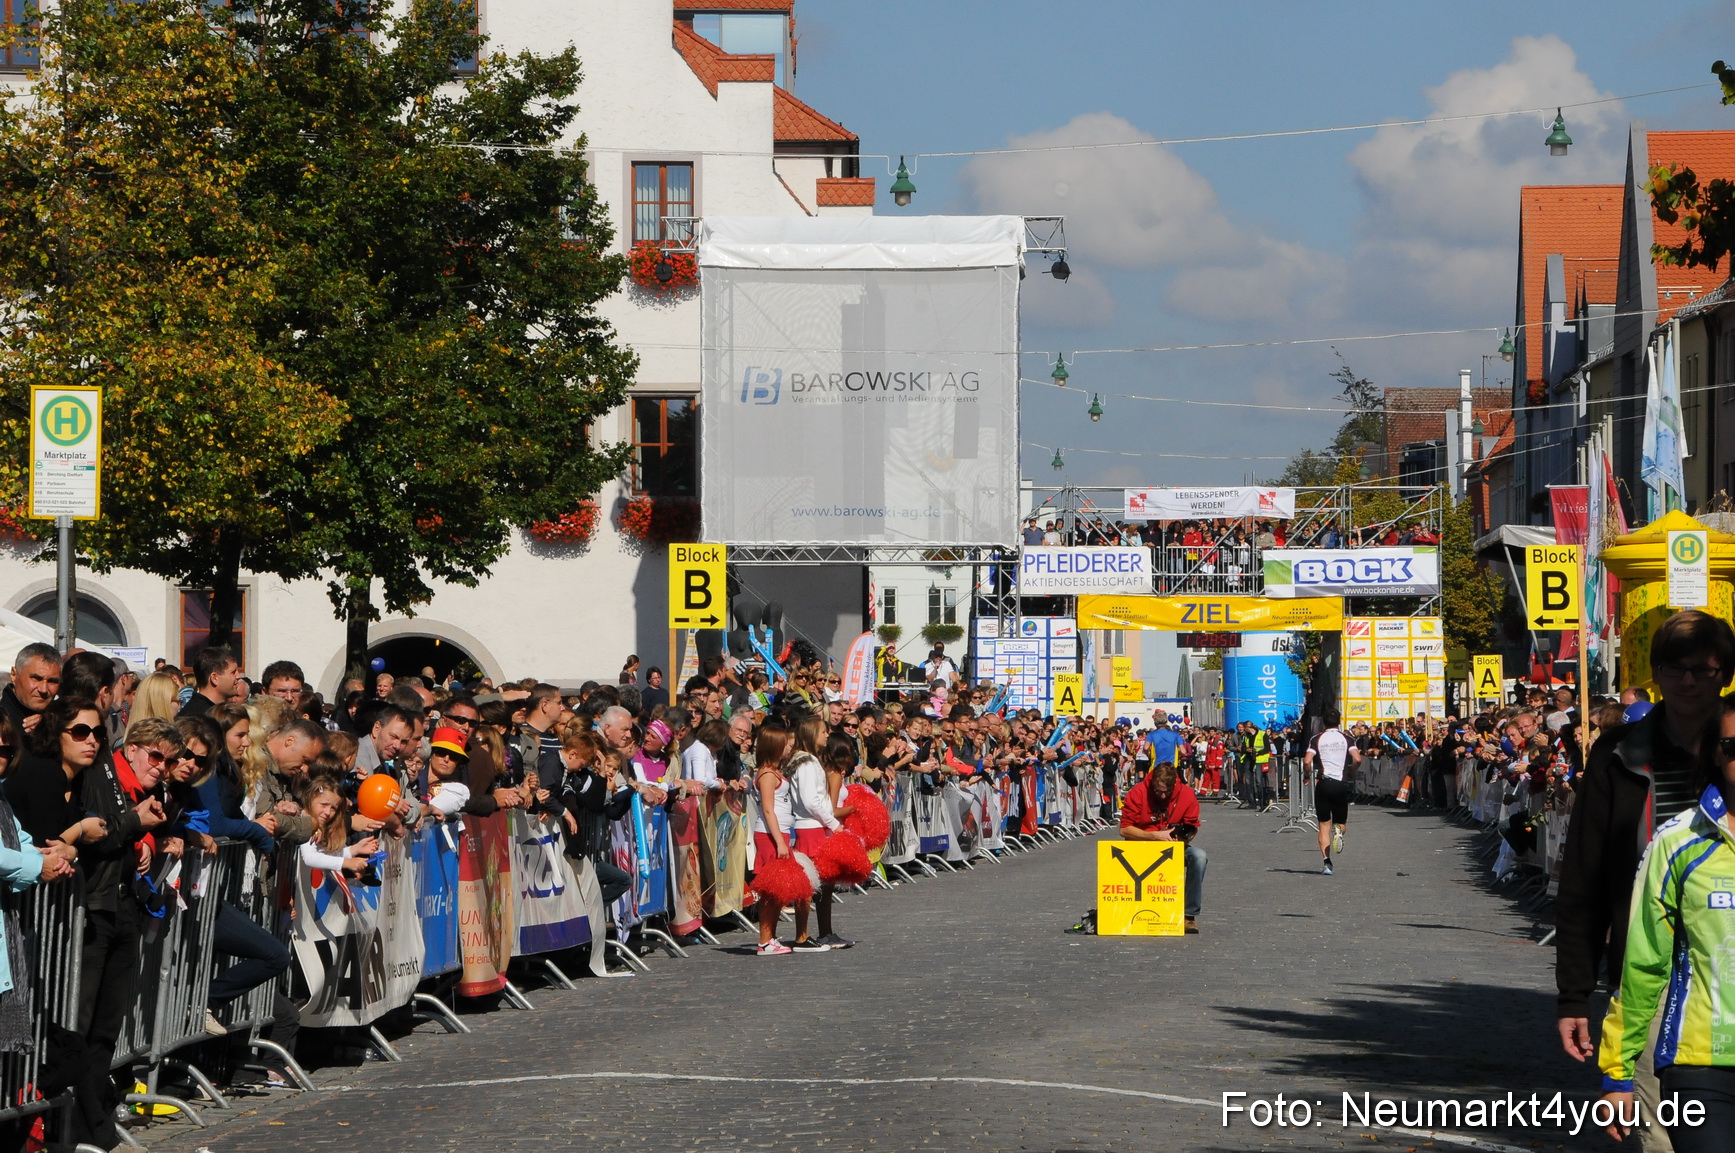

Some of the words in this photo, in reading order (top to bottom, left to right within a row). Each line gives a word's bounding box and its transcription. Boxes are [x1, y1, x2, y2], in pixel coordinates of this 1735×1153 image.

[791, 371, 932, 393] BAROWSKI
[941, 371, 980, 393] AG
[875, 394, 895, 403] und
[898, 394, 979, 404] Mediensysteme
[44, 451, 87, 461] Marktplatz
[1175, 490, 1240, 500] LEBENSSPENDER
[1190, 501, 1226, 510] WERDEN!
[791, 505, 941, 520] www.barowski-ag.de
[676, 547, 720, 562] Block
[1533, 548, 1577, 564] Block
[1023, 553, 1144, 574] PFLEIDERER
[1294, 558, 1414, 585] BOCK
[1023, 576, 1144, 587] AKTIENGESELLSCHAFT
[685, 570, 712, 609] B
[1343, 585, 1416, 595] www.bockonline.de
[1541, 570, 1570, 611] B
[1181, 603, 1239, 624] ZIEL
[1476, 656, 1500, 665] Block
[1057, 674, 1080, 683] Block
[1481, 668, 1497, 688] A
[1060, 686, 1076, 707] A
[1158, 873, 1166, 882] 2.
[1711, 876, 1735, 889] TE
[1102, 885, 1132, 894] ZIEL
[1147, 885, 1177, 895] RUNDE
